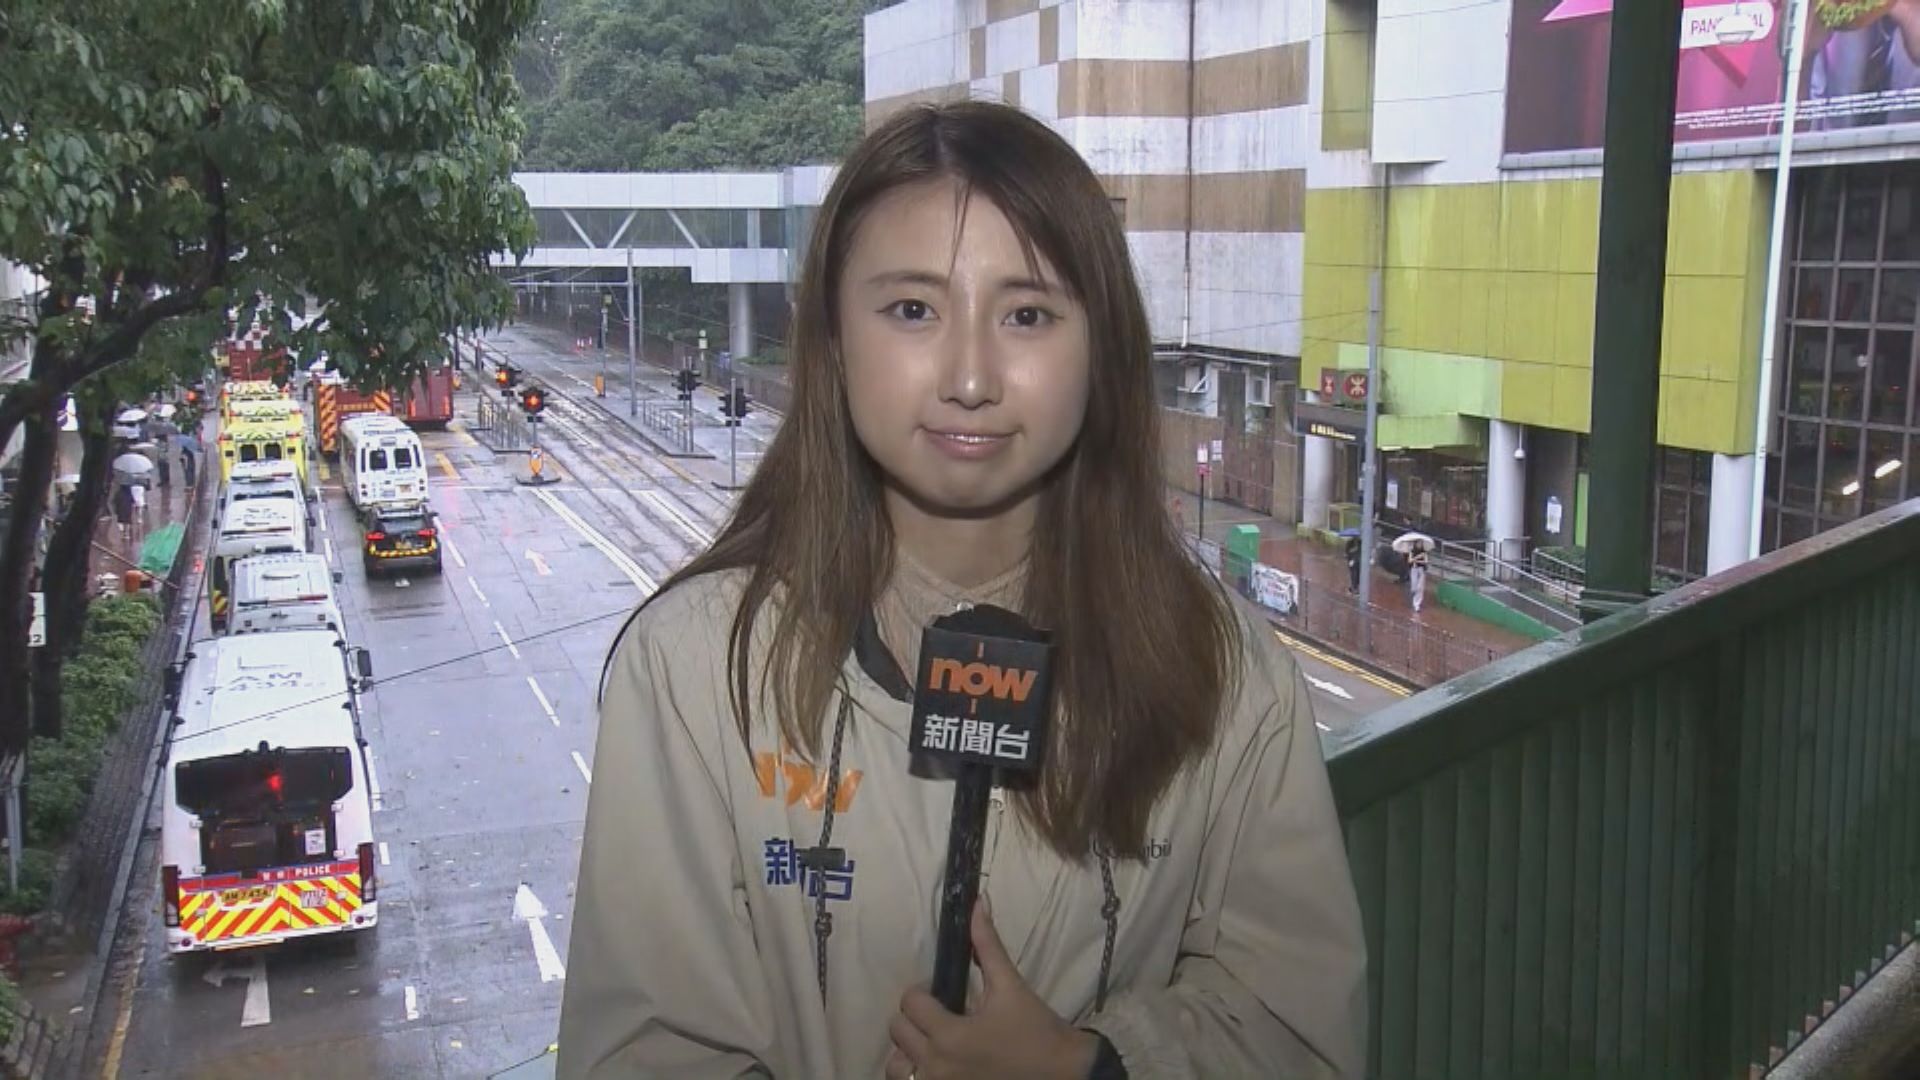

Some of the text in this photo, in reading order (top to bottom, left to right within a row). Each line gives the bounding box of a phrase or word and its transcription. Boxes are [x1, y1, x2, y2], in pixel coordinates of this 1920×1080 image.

[929, 657, 1039, 702] now
[922, 713, 1030, 759] 新聞台
[296, 865, 330, 877] POLICE
